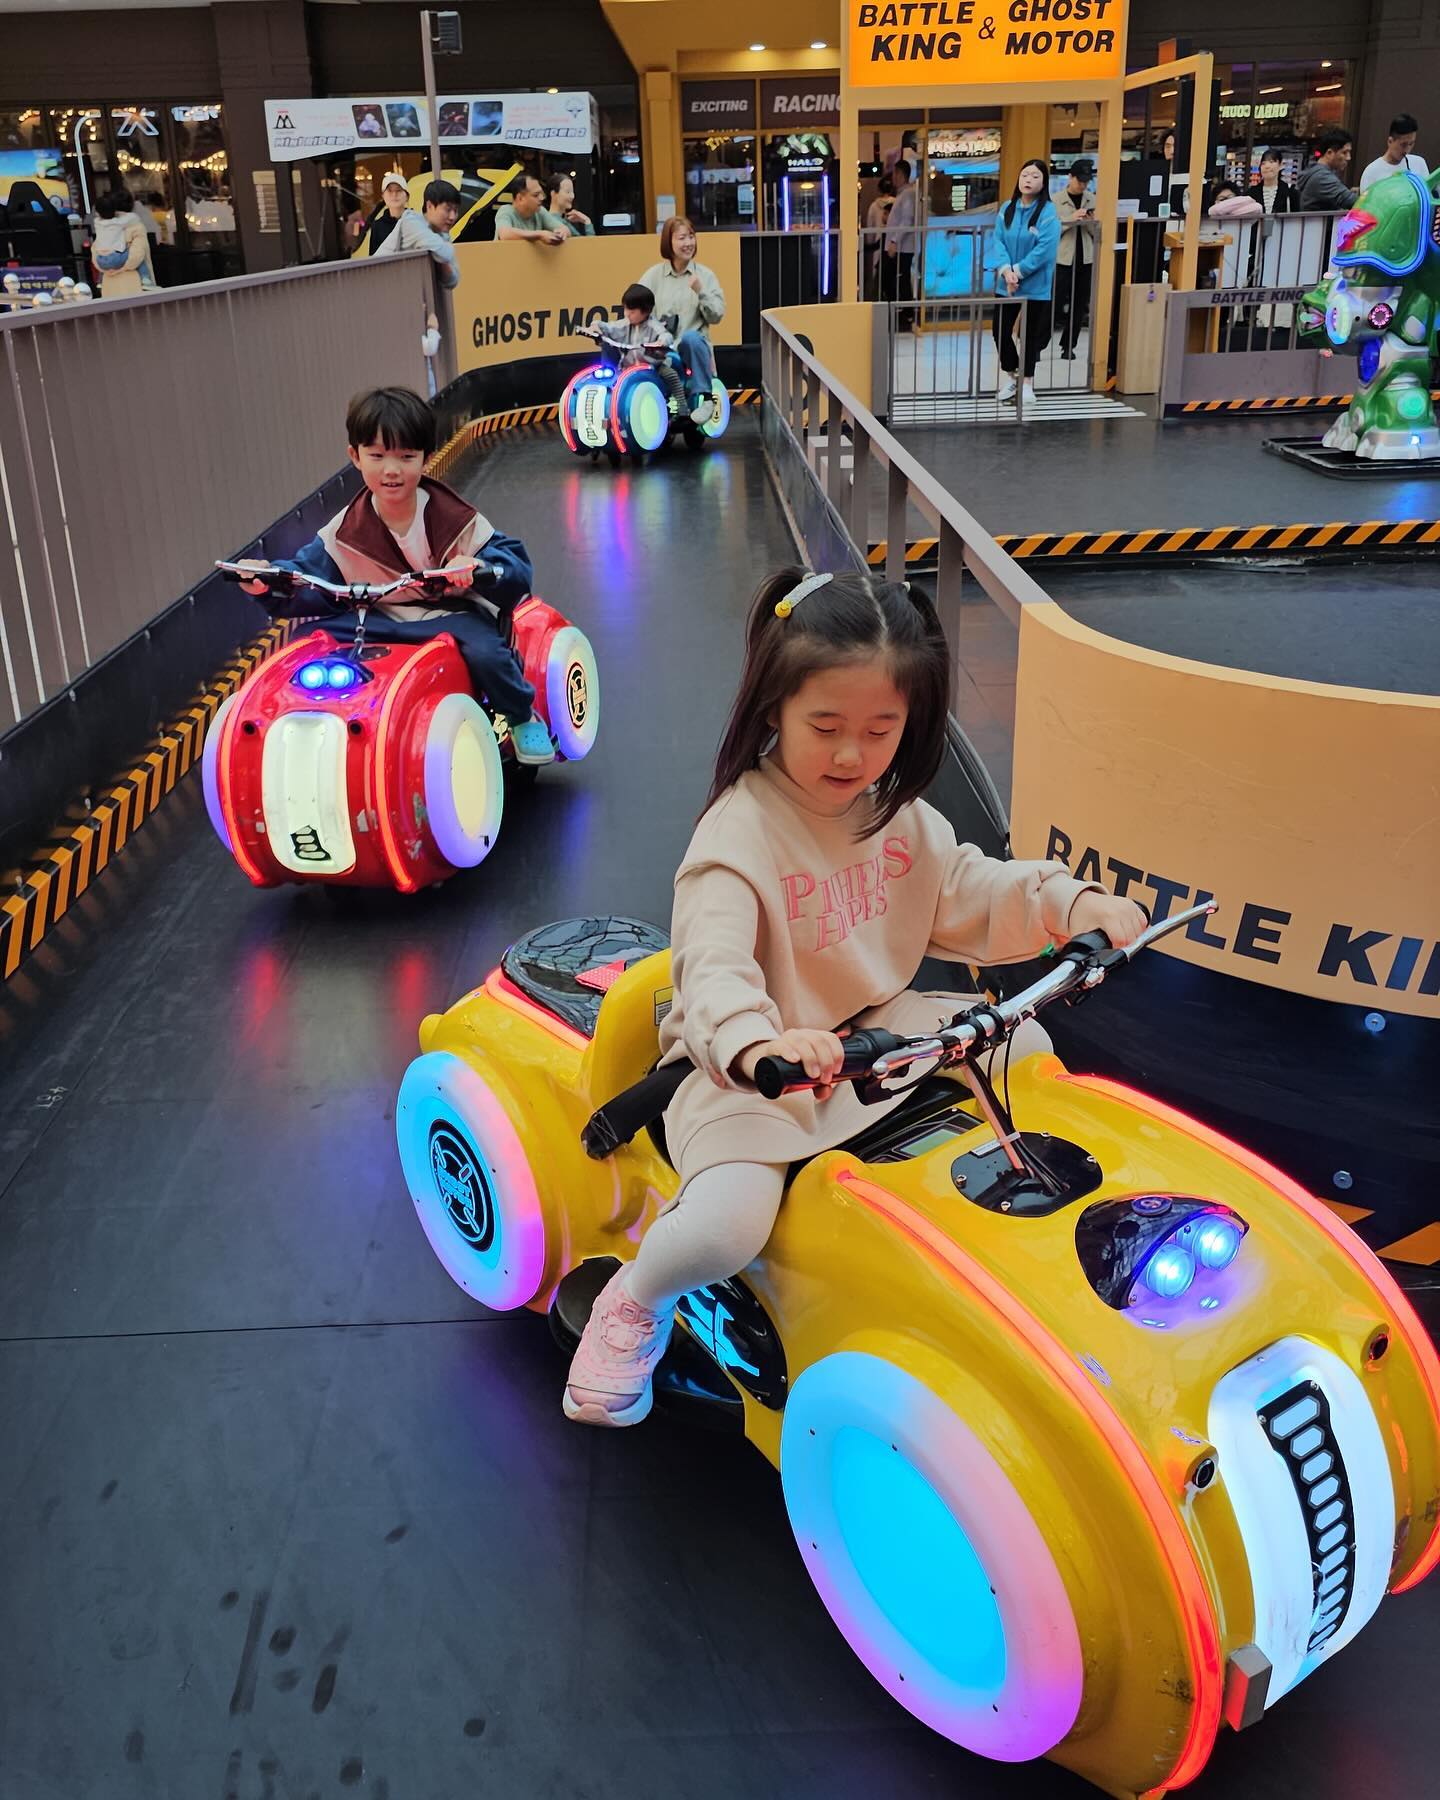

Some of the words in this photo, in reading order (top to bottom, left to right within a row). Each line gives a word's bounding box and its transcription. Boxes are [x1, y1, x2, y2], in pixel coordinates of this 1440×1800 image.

[858, 1, 976, 28] BATTLE
[1008, 0, 1112, 23] GHOST
[978, 16, 997, 40] &
[871, 32, 962, 62] KING
[1005, 29, 1115, 56] MOTOR
[691, 99, 749, 113] EXCITING
[1211, 291, 1266, 304] BATTLE
[472, 310, 551, 349] GHOST
[558, 304, 625, 337] MOT
[1045, 824, 1292, 965] BATTLE
